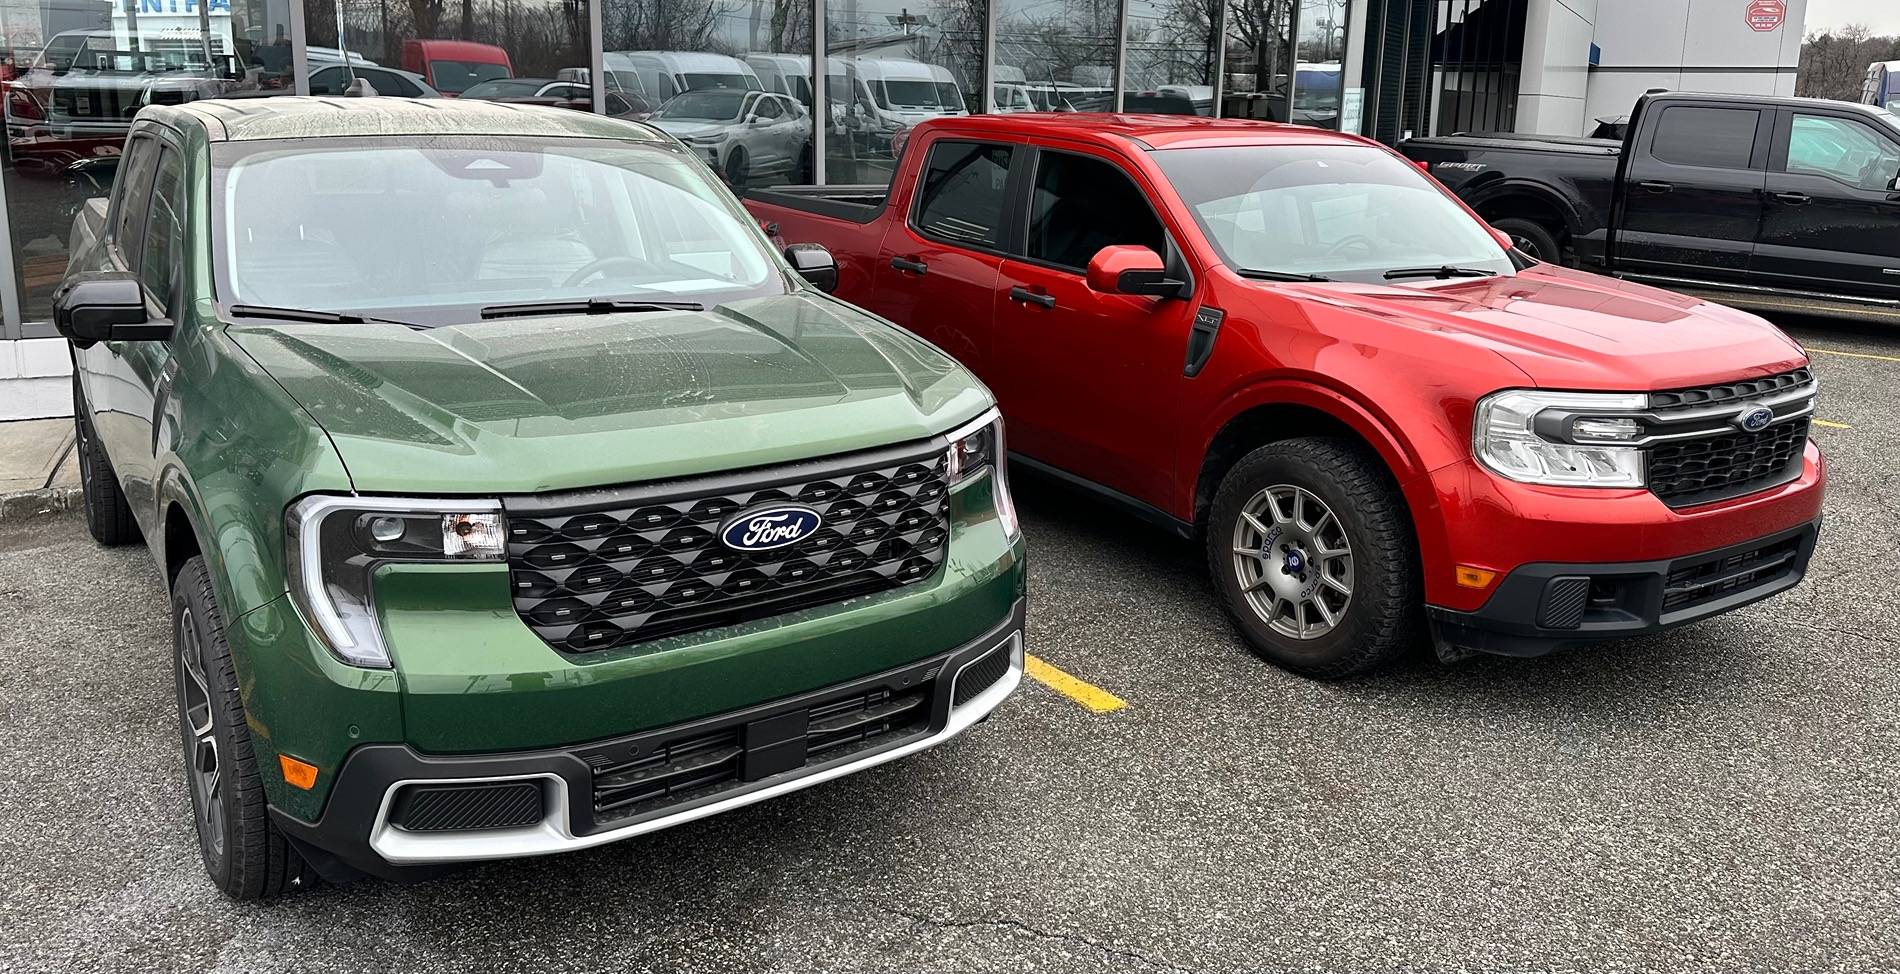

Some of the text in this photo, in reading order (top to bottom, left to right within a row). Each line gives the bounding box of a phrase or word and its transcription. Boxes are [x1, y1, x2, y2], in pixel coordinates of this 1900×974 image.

[1751, 412, 1769, 427] Ford
[743, 514, 803, 546] Ford
[1262, 526, 1282, 560] sparco
[1301, 565, 1321, 598] sparco
